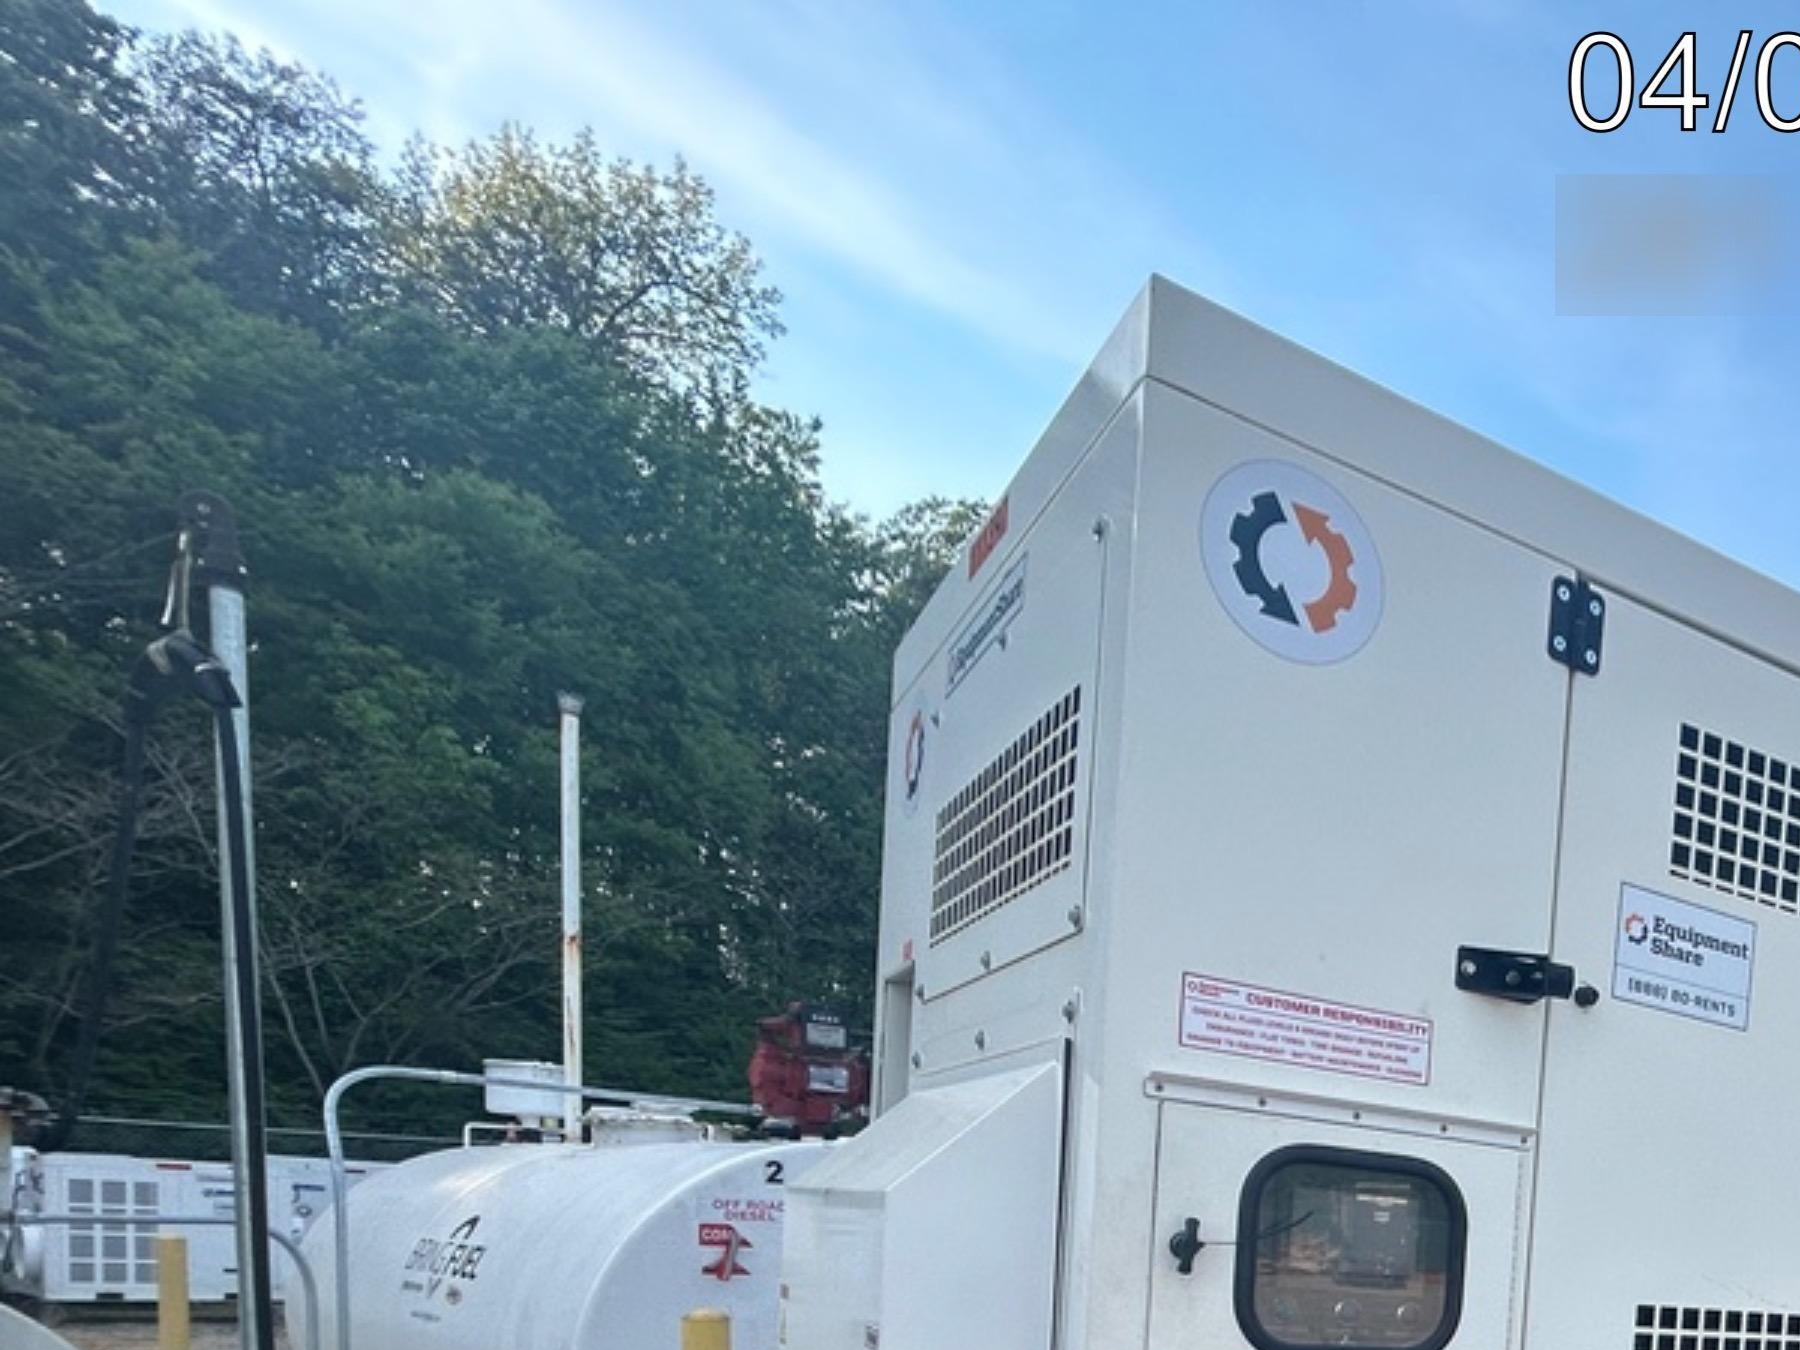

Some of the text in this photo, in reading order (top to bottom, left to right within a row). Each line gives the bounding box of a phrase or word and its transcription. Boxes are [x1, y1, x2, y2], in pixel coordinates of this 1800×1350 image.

[1650, 936, 1704, 966] Share
[1651, 915, 1750, 960] Equipment
[1246, 992, 1427, 1037] CUSTOMER RESPONSIBILITY
[764, 1160, 784, 1185] 2
